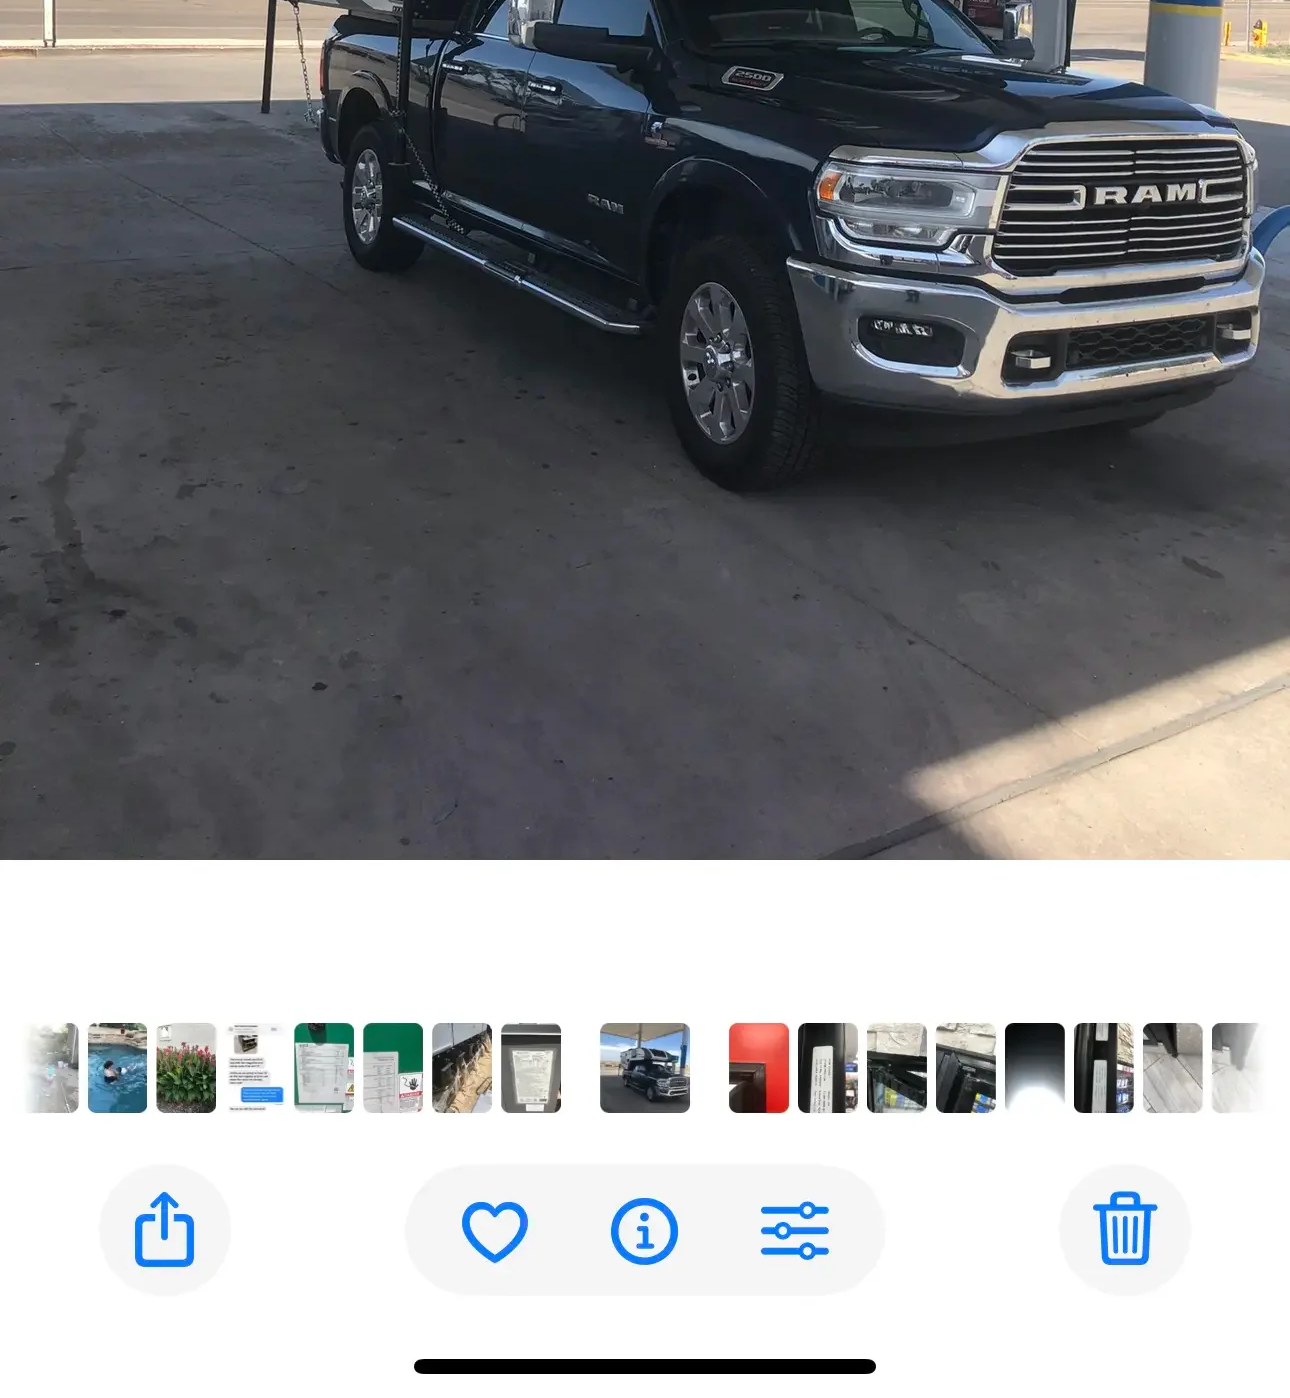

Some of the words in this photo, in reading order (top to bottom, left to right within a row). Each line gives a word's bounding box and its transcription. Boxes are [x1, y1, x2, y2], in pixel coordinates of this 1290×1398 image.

[735, 70, 772, 82] 2500
[587, 193, 624, 214] RAM
[1094, 183, 1197, 205] RAM
